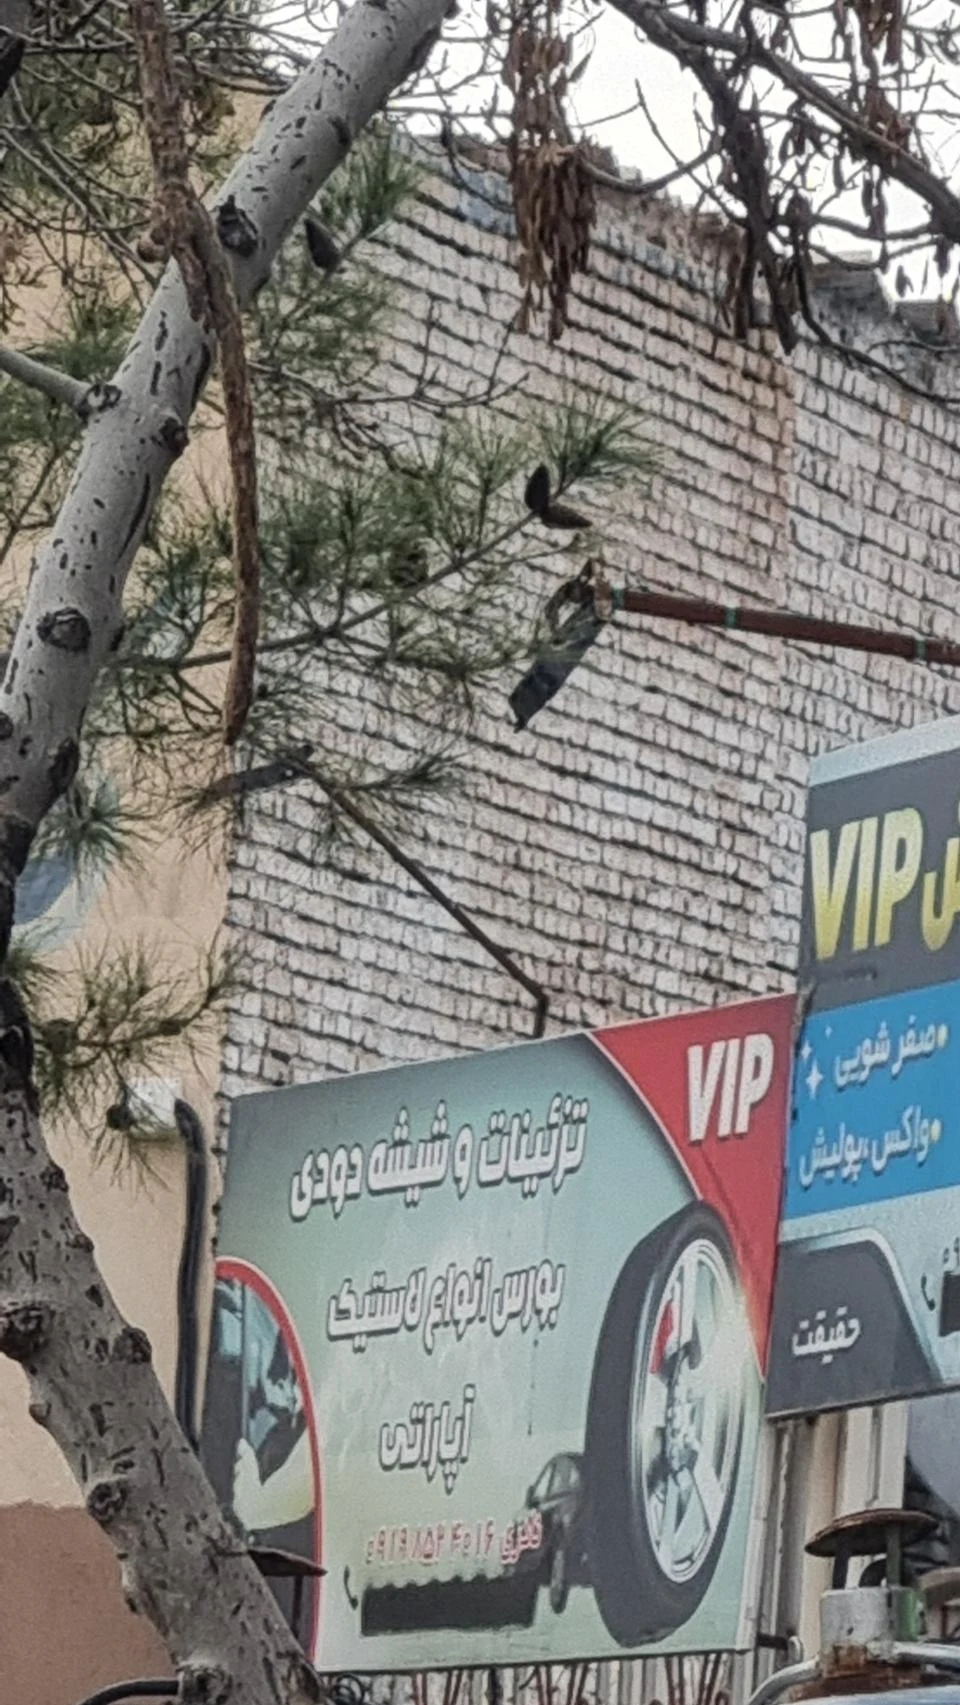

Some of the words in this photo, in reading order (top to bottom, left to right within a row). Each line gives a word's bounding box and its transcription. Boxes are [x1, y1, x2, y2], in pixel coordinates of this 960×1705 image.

[810, 808, 922, 961] VIP
[686, 1033, 774, 1141] VIP
[835, 1021, 890, 1090] شویی
[891, 1014, 936, 1079] صفر
[367, 1099, 450, 1207] شیشه
[454, 1124, 474, 1200] و
[477, 1093, 589, 1198] تزئینات
[871, 1104, 930, 1171] واکس
[289, 1143, 363, 1222] دودی
[327, 1267, 427, 1353] لاستیک
[424, 1256, 492, 1355] انواع
[491, 1259, 566, 1337] بورس
[792, 1306, 861, 1366] حقیقت
[379, 1383, 476, 1495] آپاراتی
